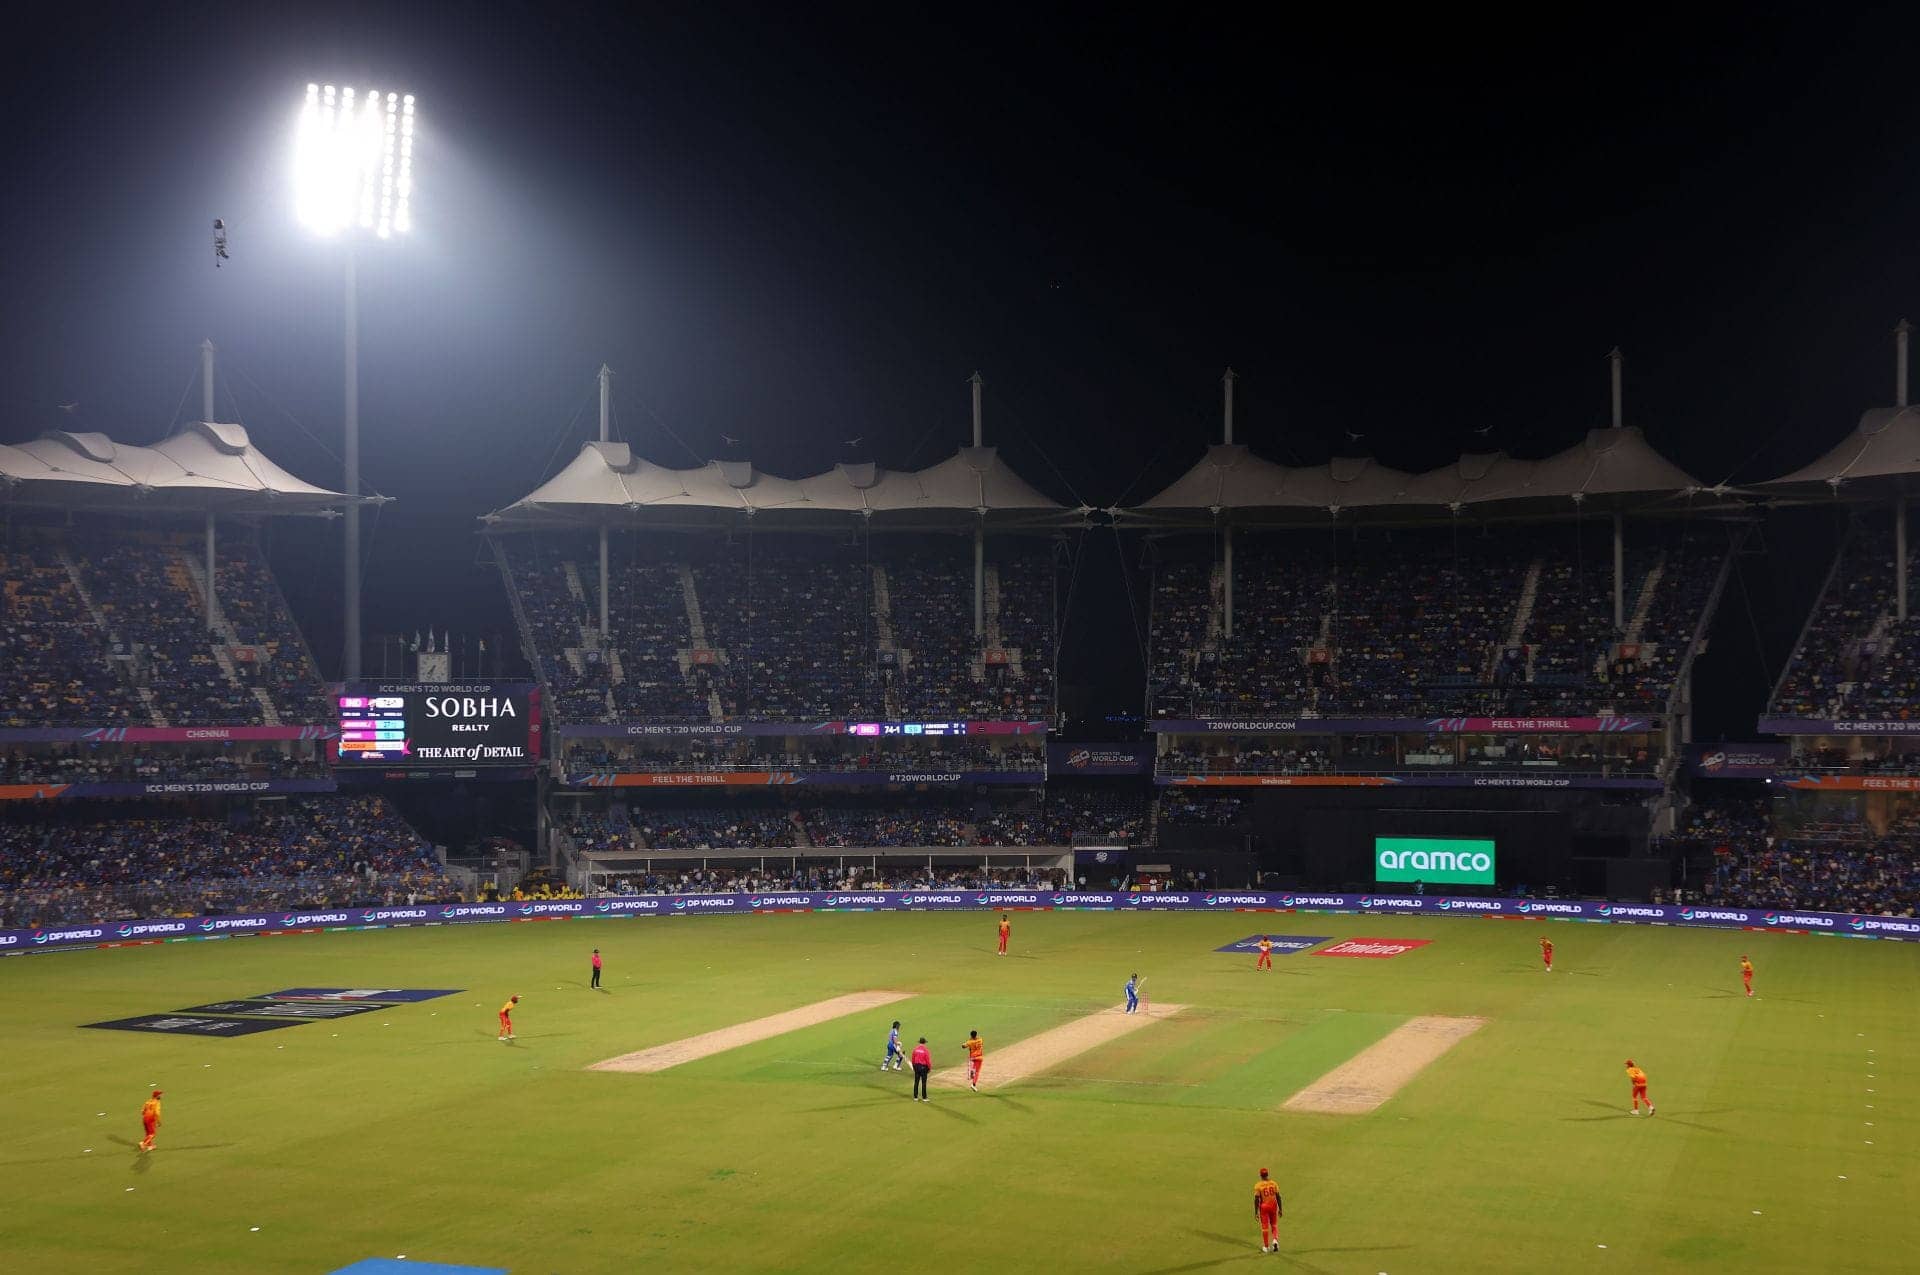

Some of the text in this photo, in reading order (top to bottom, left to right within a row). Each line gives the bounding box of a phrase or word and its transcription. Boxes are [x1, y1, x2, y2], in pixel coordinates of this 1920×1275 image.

[425, 697, 516, 718] SOBHA
[452, 724, 490, 732] REALTY
[1207, 722, 1296, 730] T20WORLDCUP.COM
[1492, 720, 1570, 728] FEEL THE THRILL
[627, 726, 642, 734] ICC
[724, 725, 742, 733] CUP
[417, 744, 524, 760] THE ART of DETAIL
[652, 775, 726, 783] FEEL THE THRILL
[889, 774, 961, 782] #T20WORLDCUP
[164, 784, 194, 792] MEN'S
[195, 783, 213, 791] T20
[213, 783, 249, 791] WORLD
[250, 782, 270, 790] CUP
[1379, 850, 1491, 872] aramco
[701, 899, 734, 907] WORLD
[852, 896, 885, 904] WORLD
[535, 904, 581, 913] DP WORLD
[625, 901, 658, 909] WORLD
[1452, 901, 1501, 910] DP WORLD
[1544, 905, 1581, 913] WORLD
[377, 910, 426, 920] DP WORLD
[456, 907, 504, 916] DP WORLD
[1613, 907, 1663, 917] DP WORLD
[297, 914, 347, 924] DP WORLD
[1695, 911, 1747, 922] DP WORLD
[216, 919, 266, 929] DP WORLD
[1780, 916, 1833, 927] DP WORLD
[133, 923, 185, 934] DP WORLD
[1866, 921, 1920, 933] DP WORLD
[49, 930, 102, 941] DP WORLD
